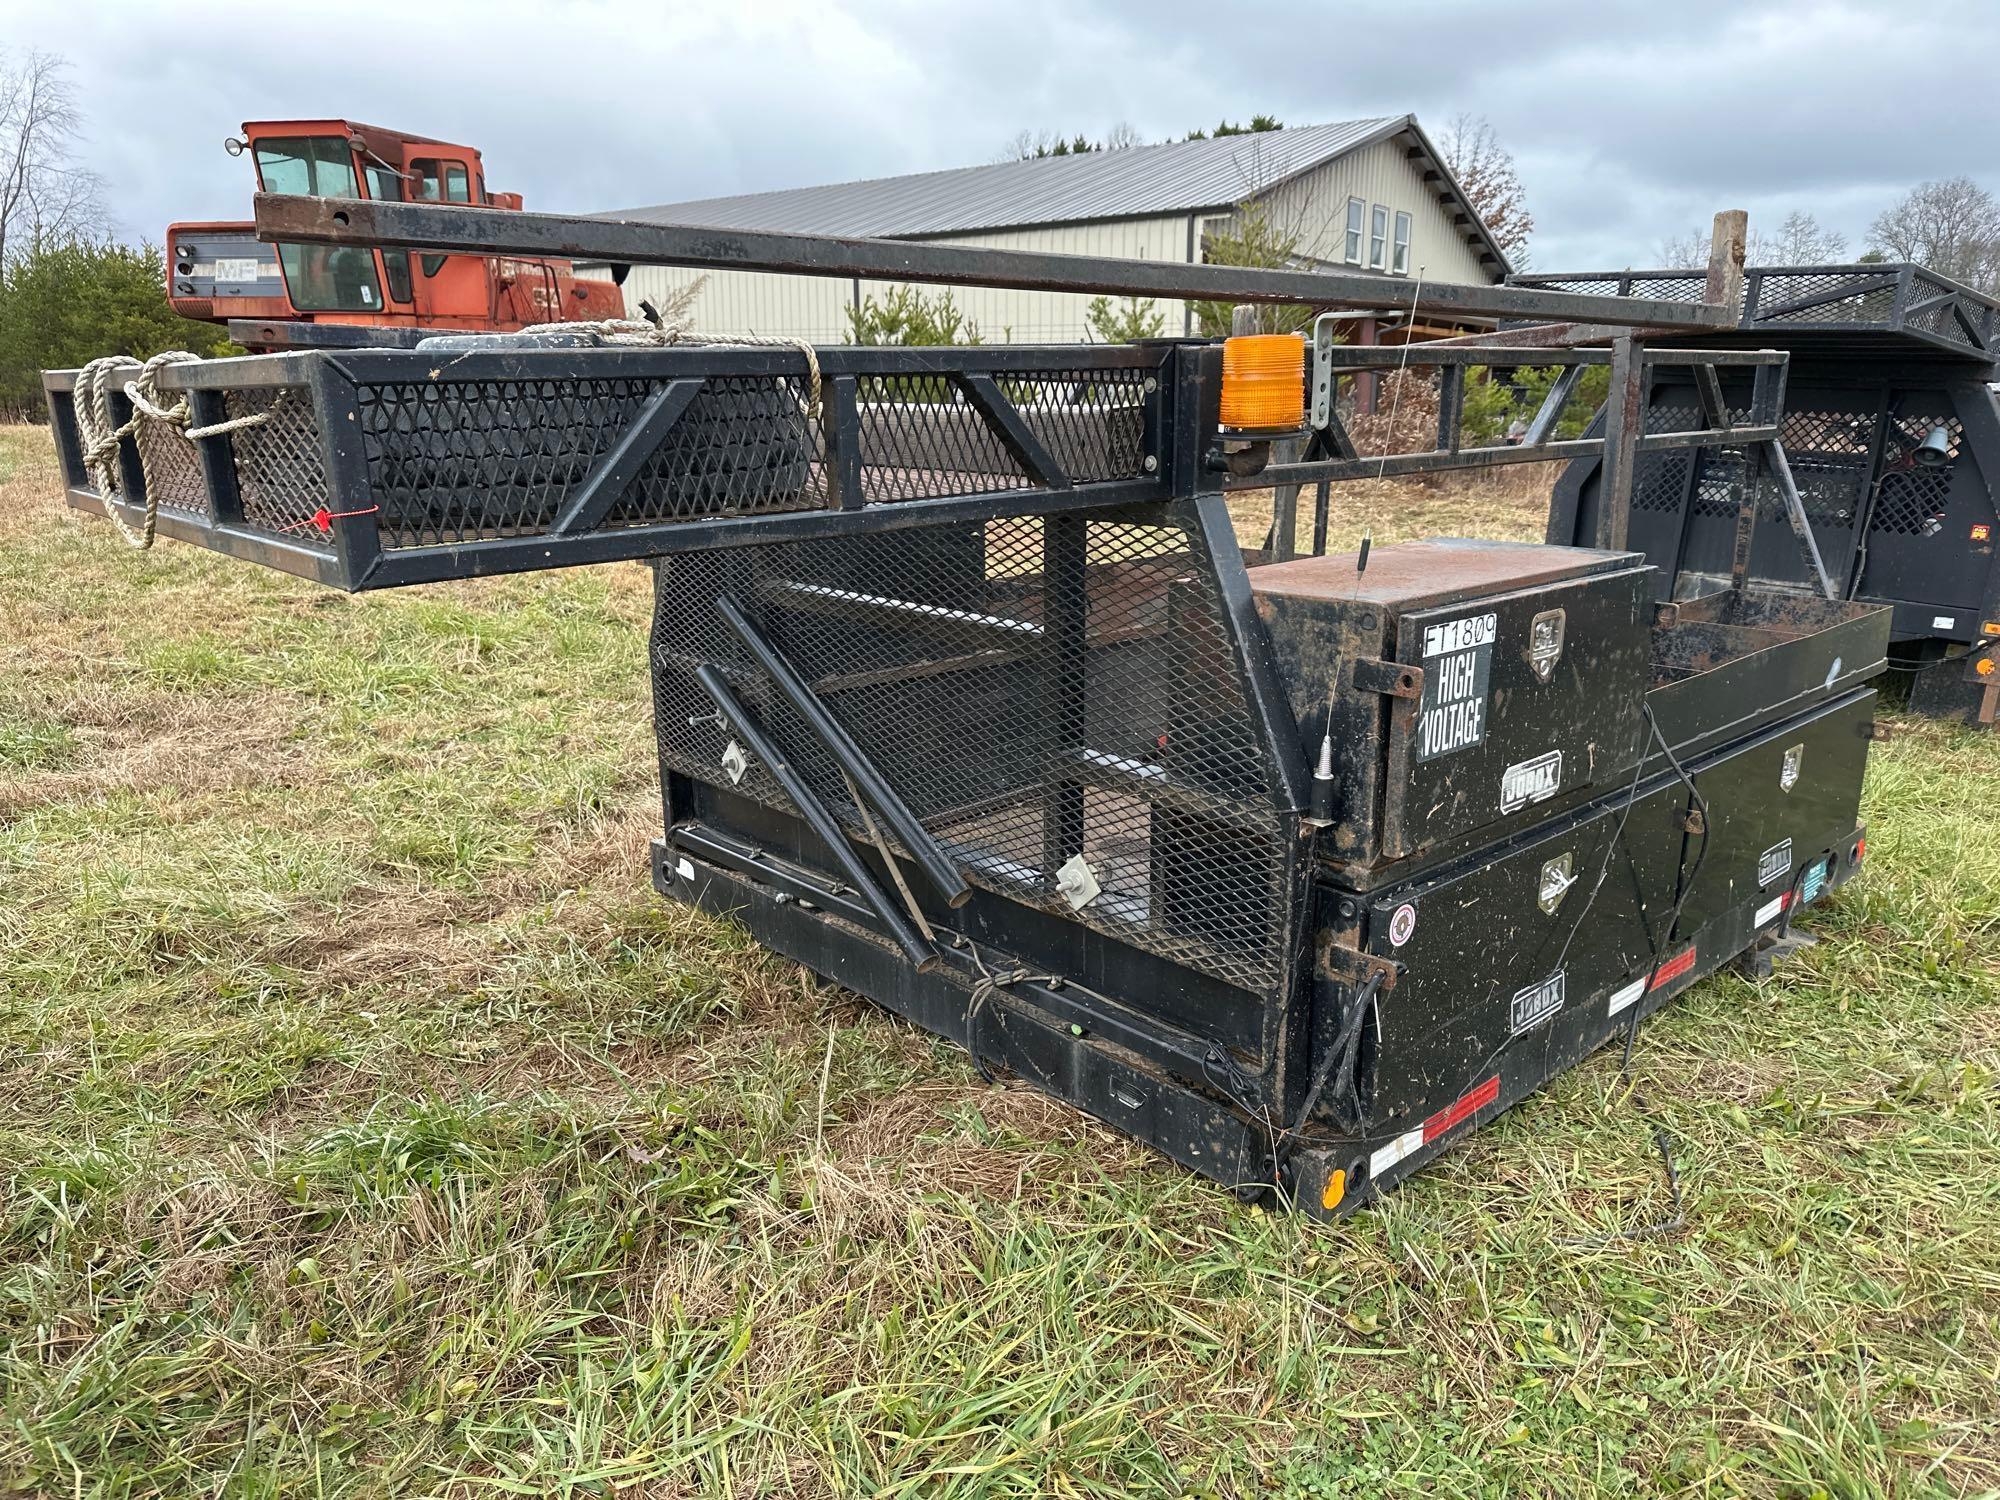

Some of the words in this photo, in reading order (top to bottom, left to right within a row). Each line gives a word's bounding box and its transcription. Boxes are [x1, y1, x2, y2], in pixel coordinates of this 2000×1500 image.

[1425, 614, 1496, 655] FT1809
[1437, 651, 1476, 705] HIGH
[1423, 697, 1482, 757] VOLTAGE
